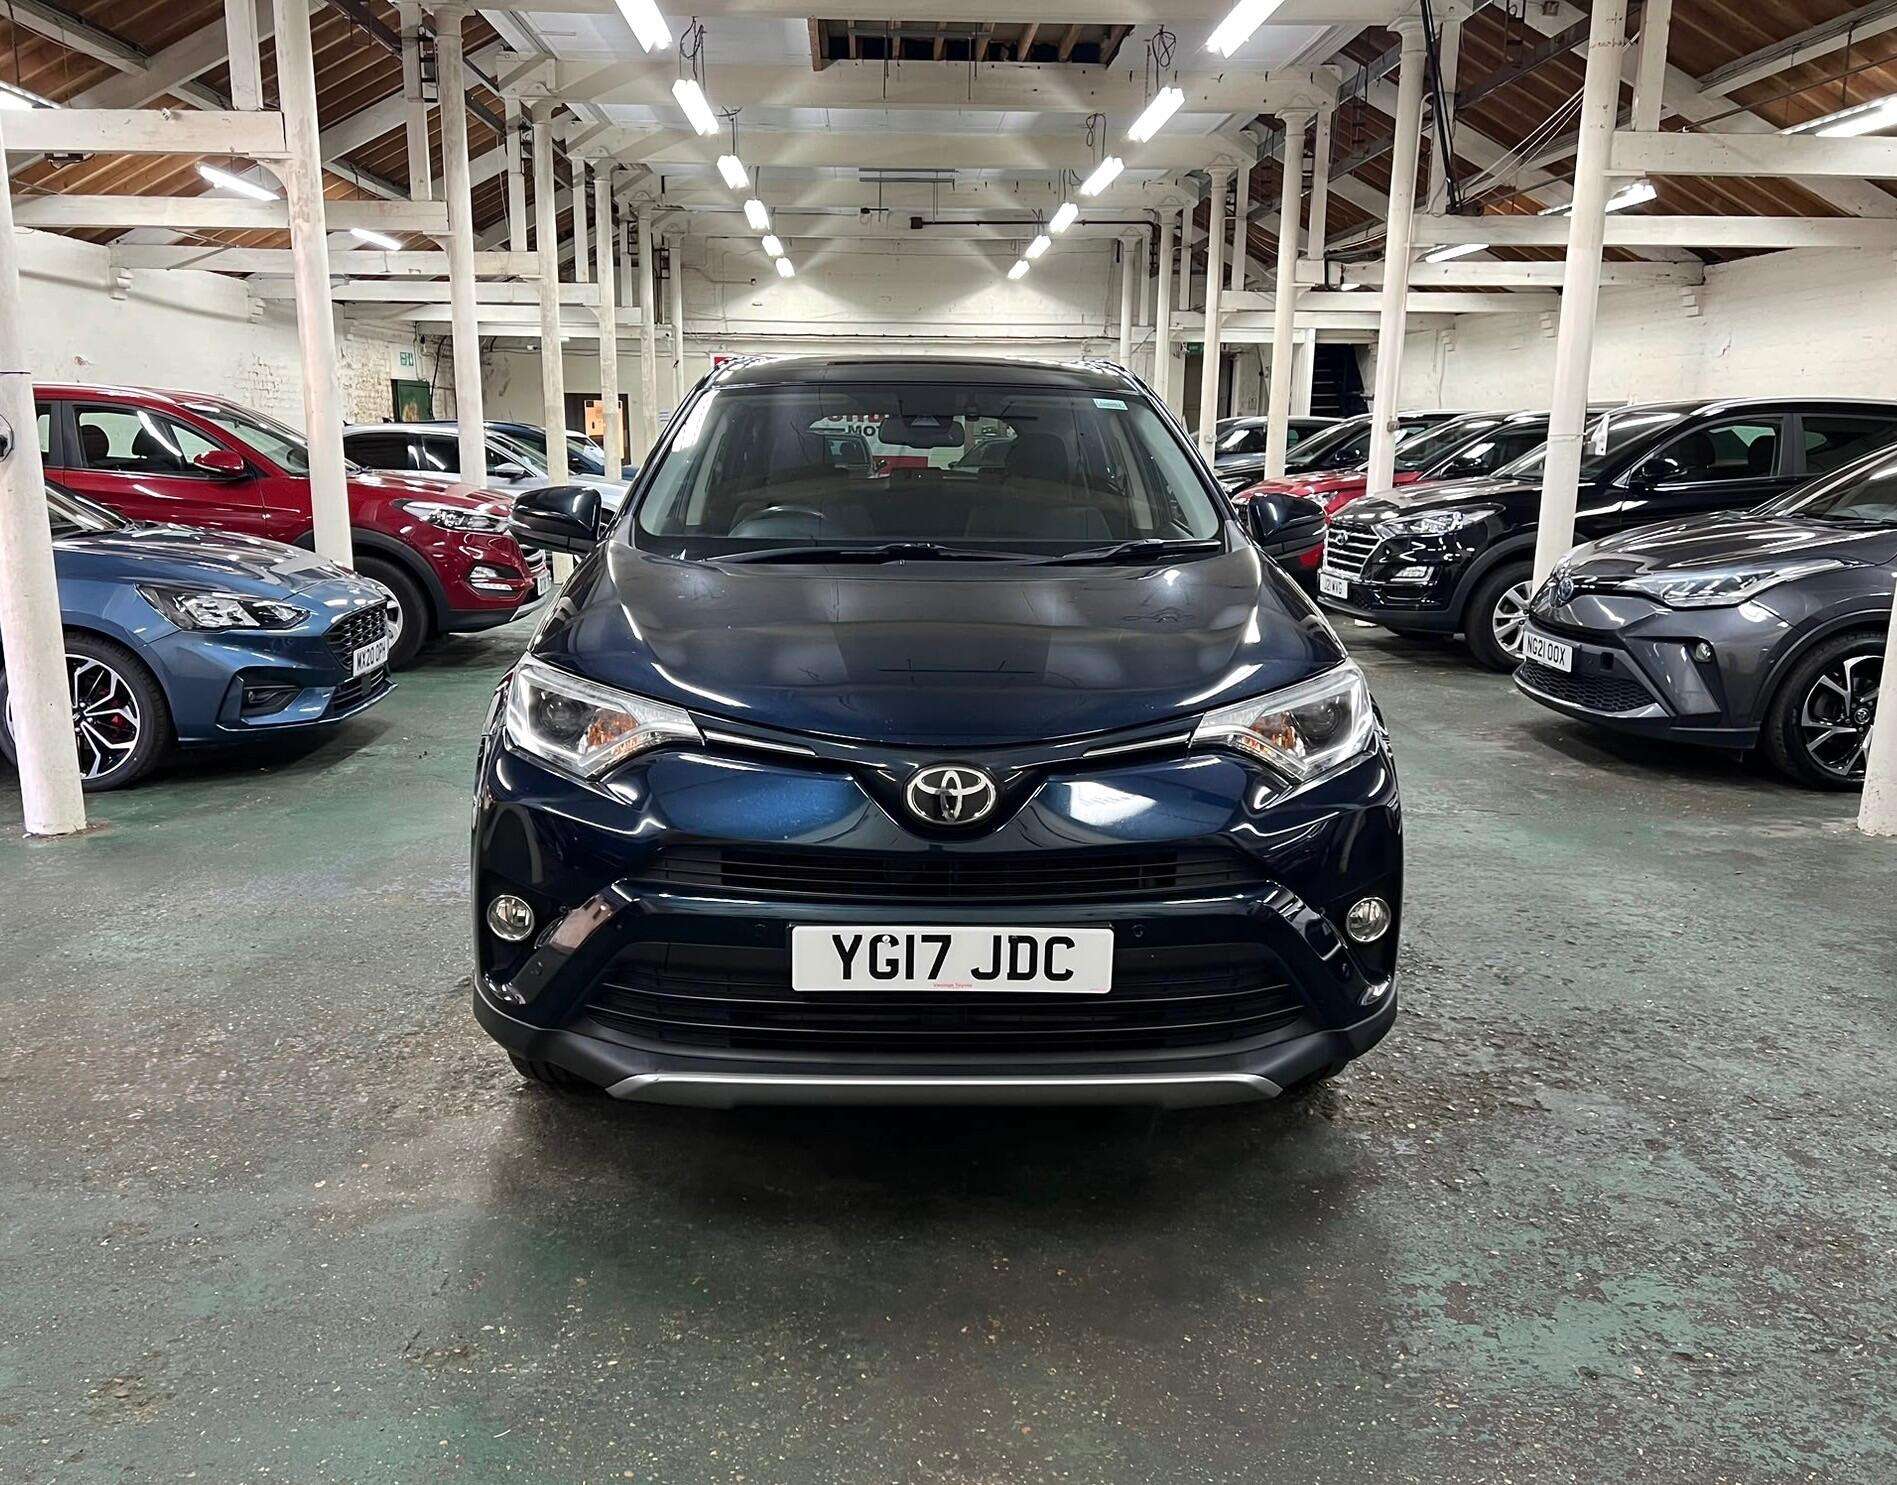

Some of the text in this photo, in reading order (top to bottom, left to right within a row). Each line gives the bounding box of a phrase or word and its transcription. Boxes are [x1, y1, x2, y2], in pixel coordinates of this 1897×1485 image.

[1527, 635, 1566, 665] NG21 OOX
[831, 934, 1076, 982] YG17 JDC
